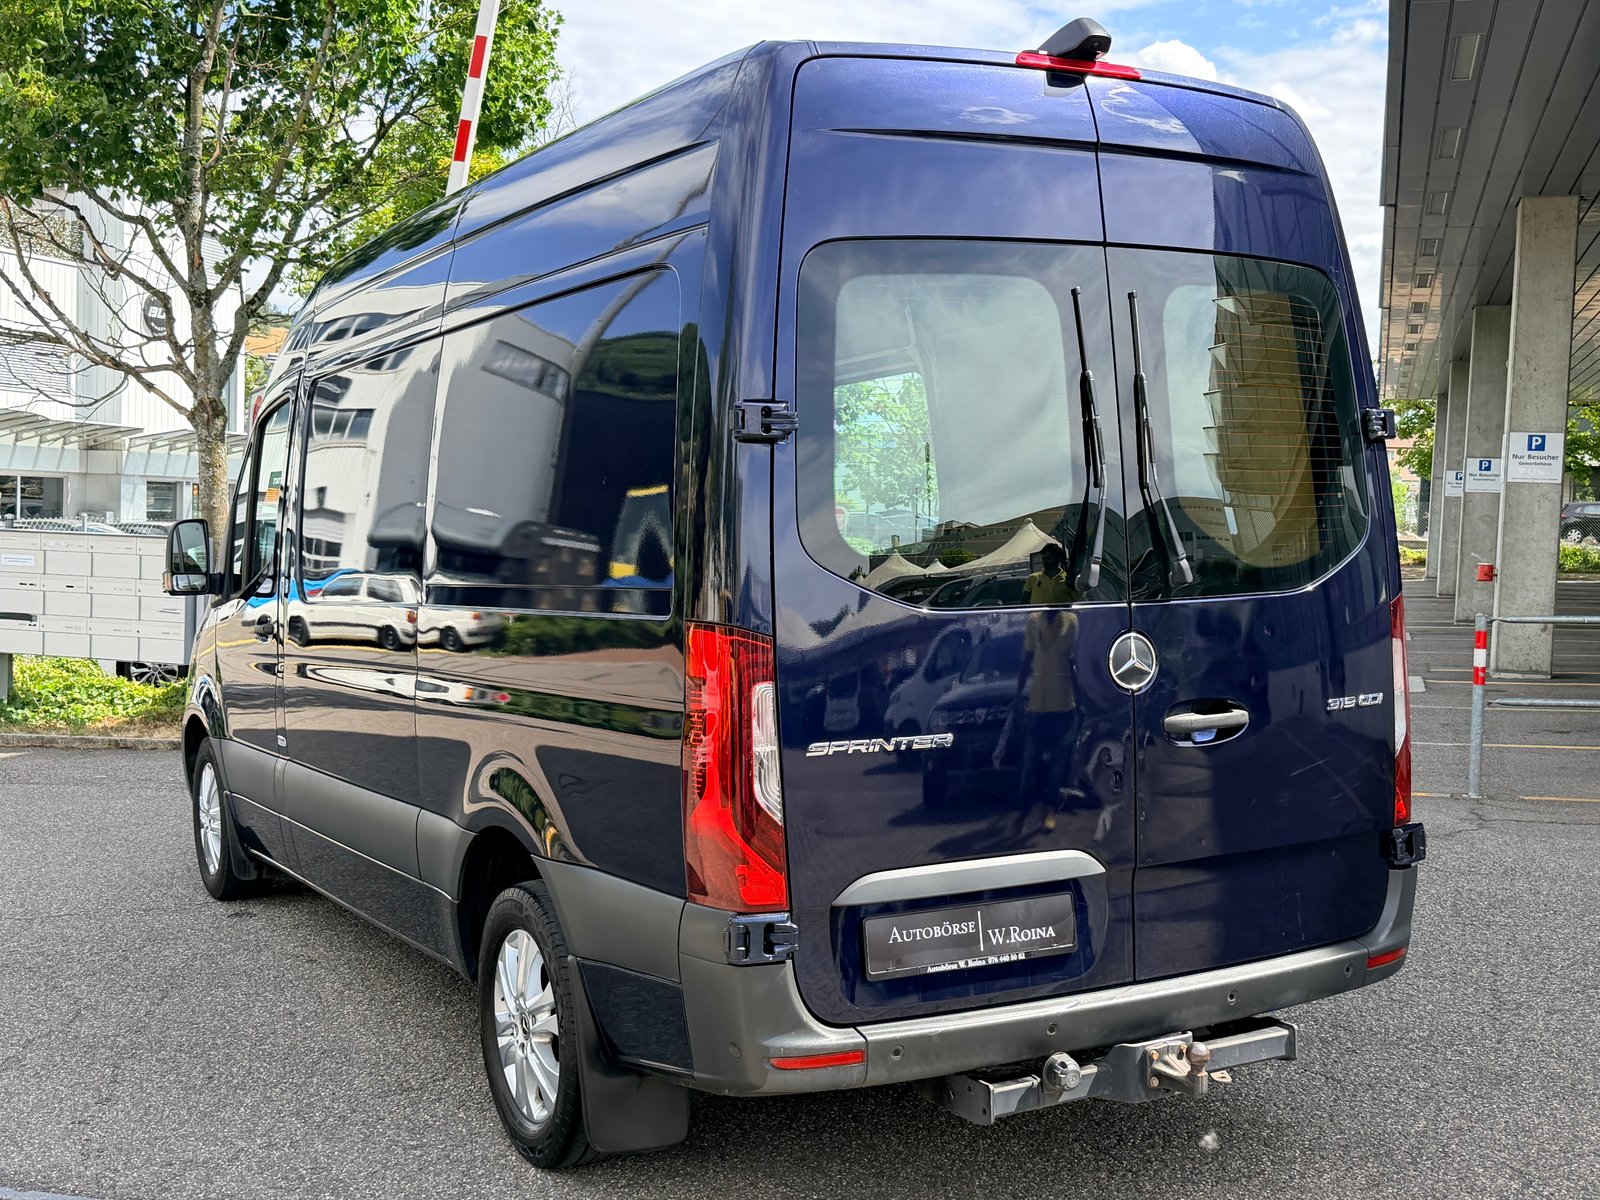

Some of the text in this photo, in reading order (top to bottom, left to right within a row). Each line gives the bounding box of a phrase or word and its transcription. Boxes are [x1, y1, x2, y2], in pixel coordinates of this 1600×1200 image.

[1531, 436, 1542, 450] P
[1481, 460, 1489, 470] P
[1327, 696, 1356, 710] 319
[805, 732, 954, 757] SPRINTER
[888, 921, 976, 944] AUTOBÖRSE
[927, 961, 958, 973] Autobörse
[958, 960, 967, 969] W.
[968, 958, 986, 967] Roina
[987, 956, 998, 965] 076
[999, 954, 1010, 963] 440
[1010, 953, 1017, 961] 50
